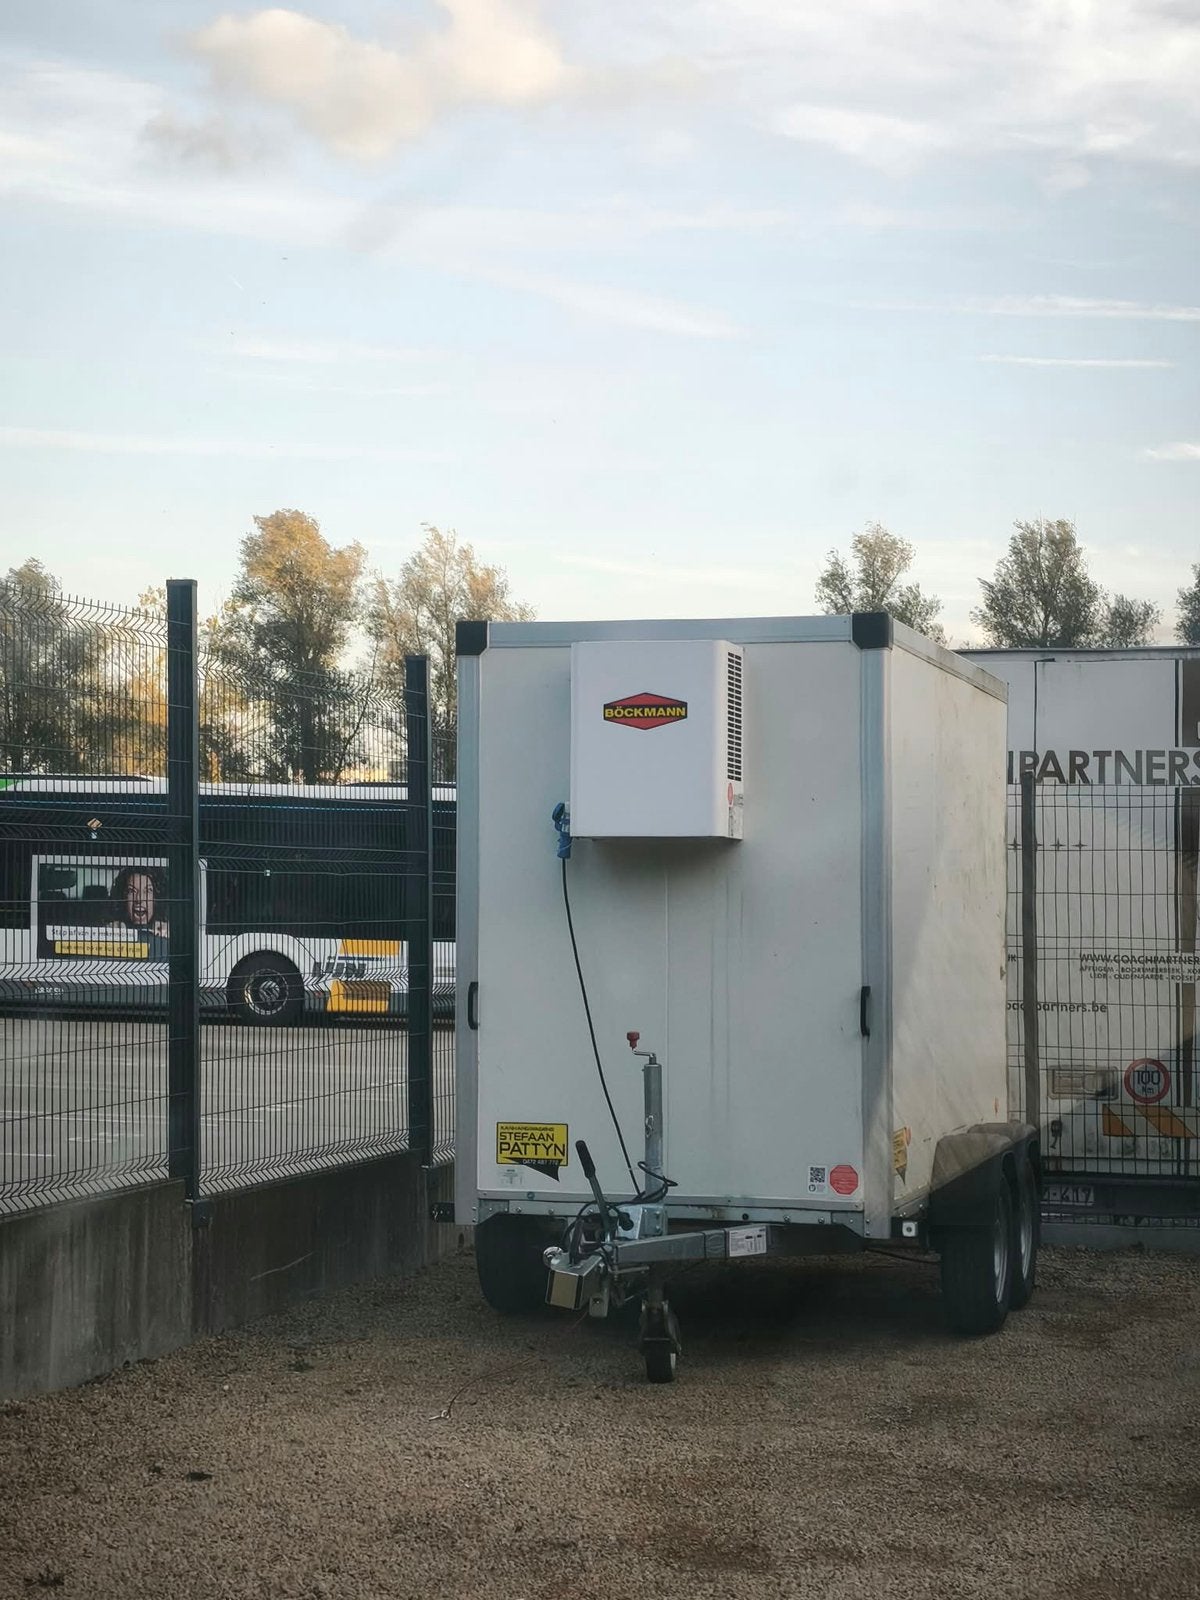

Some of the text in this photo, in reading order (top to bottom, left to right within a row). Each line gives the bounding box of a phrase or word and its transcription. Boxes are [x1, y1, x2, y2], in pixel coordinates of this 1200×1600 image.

[605, 706, 685, 718] BÖCKMANN
[1008, 750, 1200, 784] PARTNER
[1007, 1001, 1107, 1013] oacpartners.be
[1135, 1071, 1160, 1084] 100
[500, 1132, 554, 1142] STEFAAN
[499, 1142, 565, 1156] PATTYN
